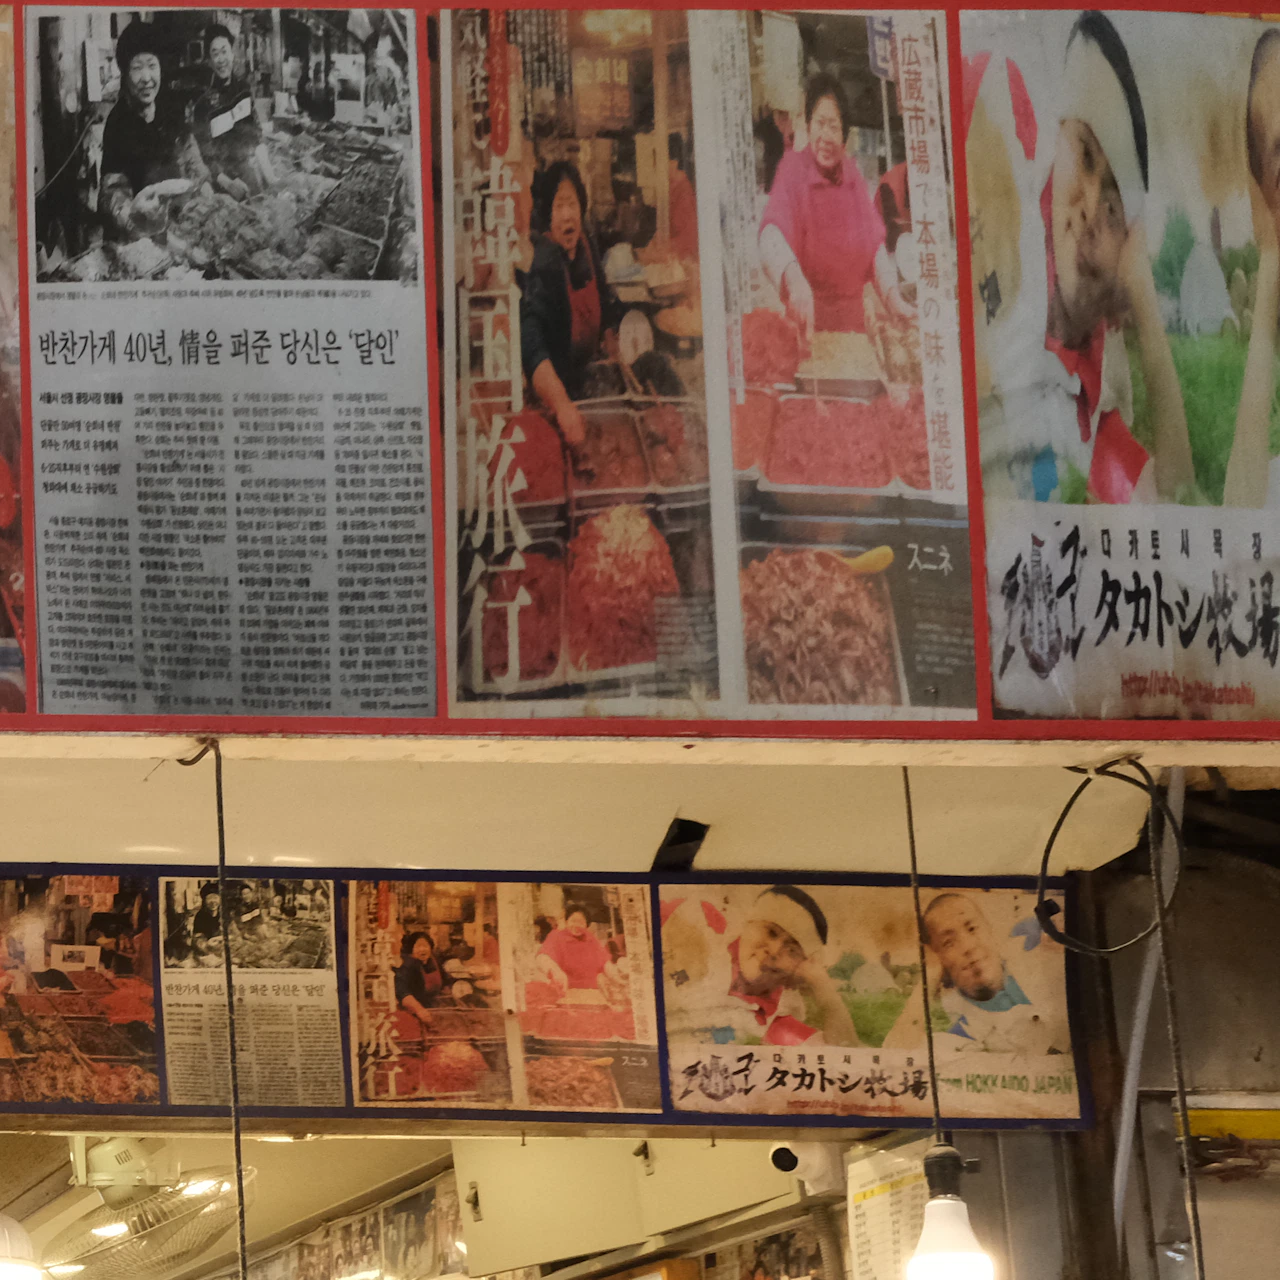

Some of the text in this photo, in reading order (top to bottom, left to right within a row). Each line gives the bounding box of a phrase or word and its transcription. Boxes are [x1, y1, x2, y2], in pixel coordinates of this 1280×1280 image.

[38, 328, 117, 366] 반찬가게
[123, 329, 174, 367] 40년,
[180, 328, 224, 366] 情을
[230, 328, 273, 366] 퍼준
[280, 328, 343, 366] 당신은
[164, 982, 201, 997] 반찬가게
[764, 1066, 930, 1101] タカトシ牧場
[1032, 1075, 1074, 1095] JAPAN
